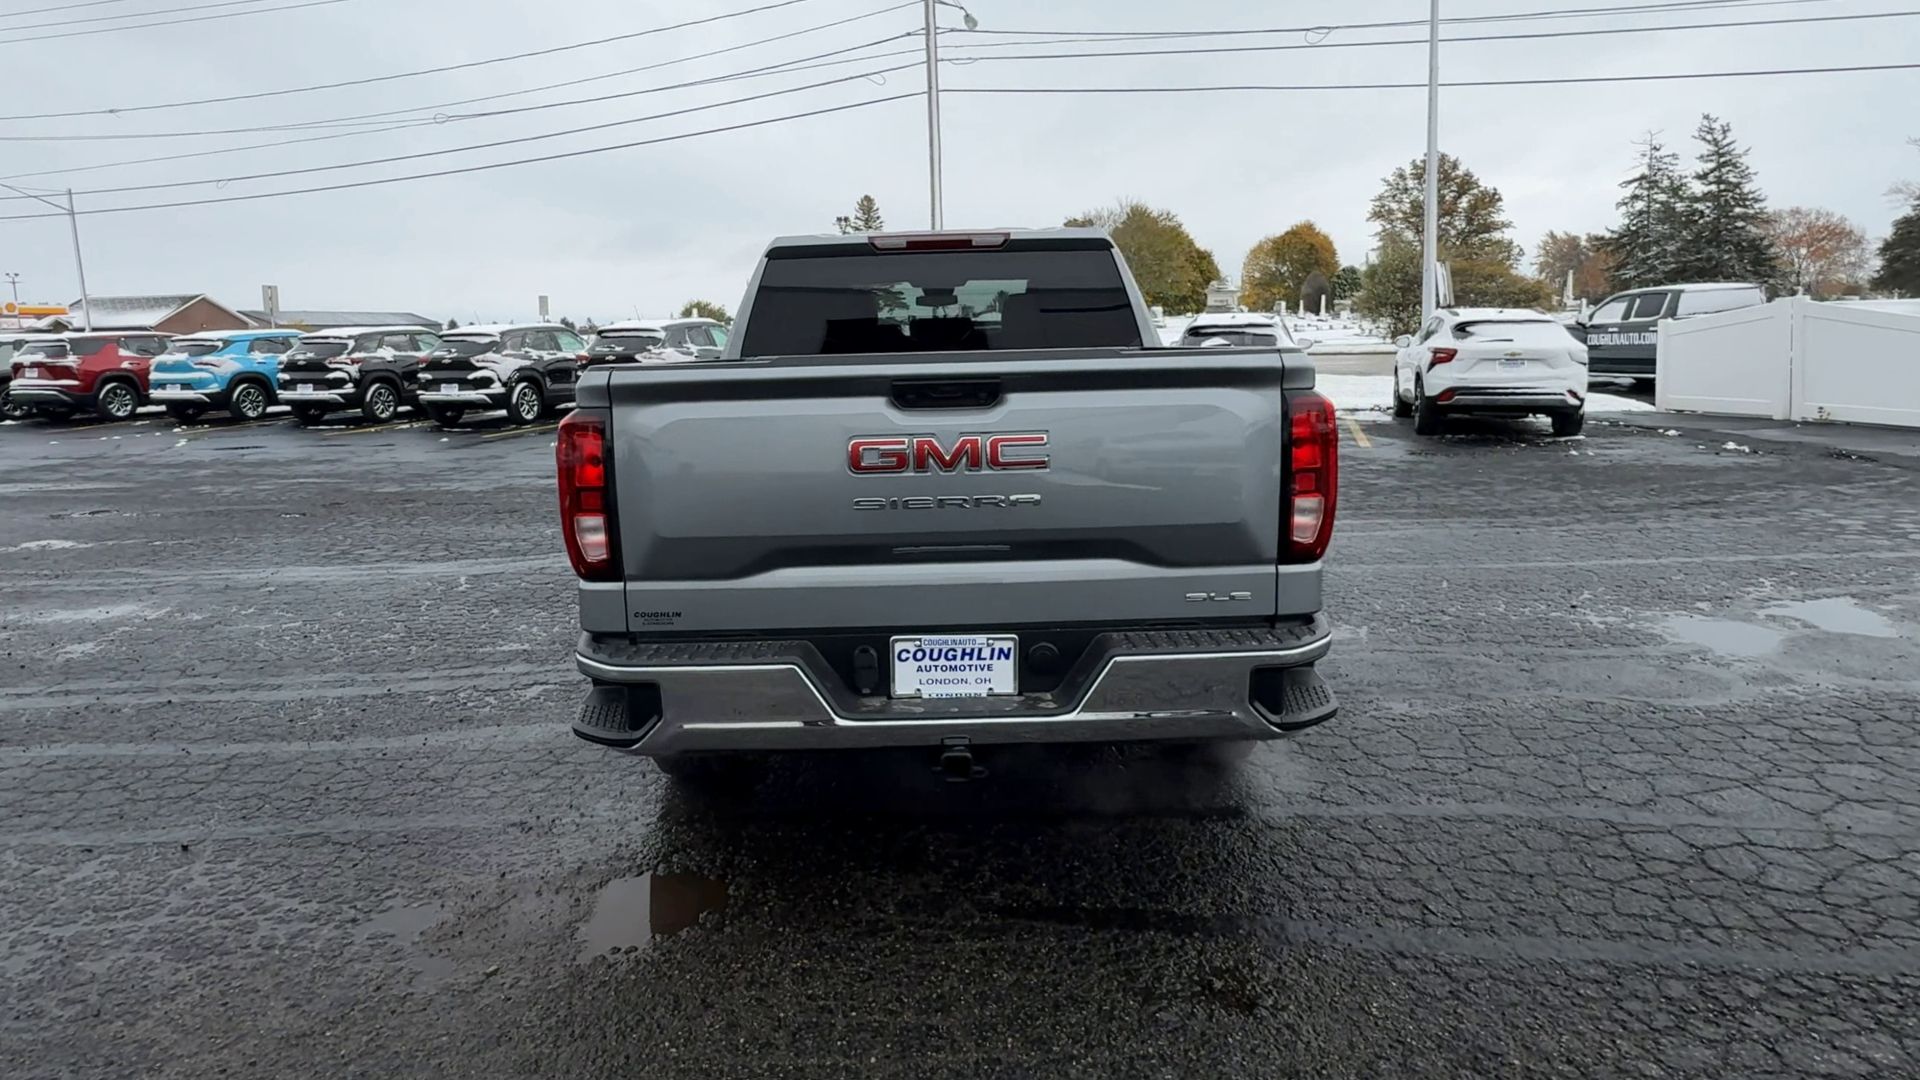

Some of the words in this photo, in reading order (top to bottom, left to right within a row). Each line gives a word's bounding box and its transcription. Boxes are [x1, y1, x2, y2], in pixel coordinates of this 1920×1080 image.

[848, 433, 1049, 475] GMC
[853, 494, 1041, 510] SIERRA
[1185, 591, 1252, 602] SLE
[897, 647, 1012, 663] COUGHLIN
[916, 664, 994, 673] AUTOMOTIVE
